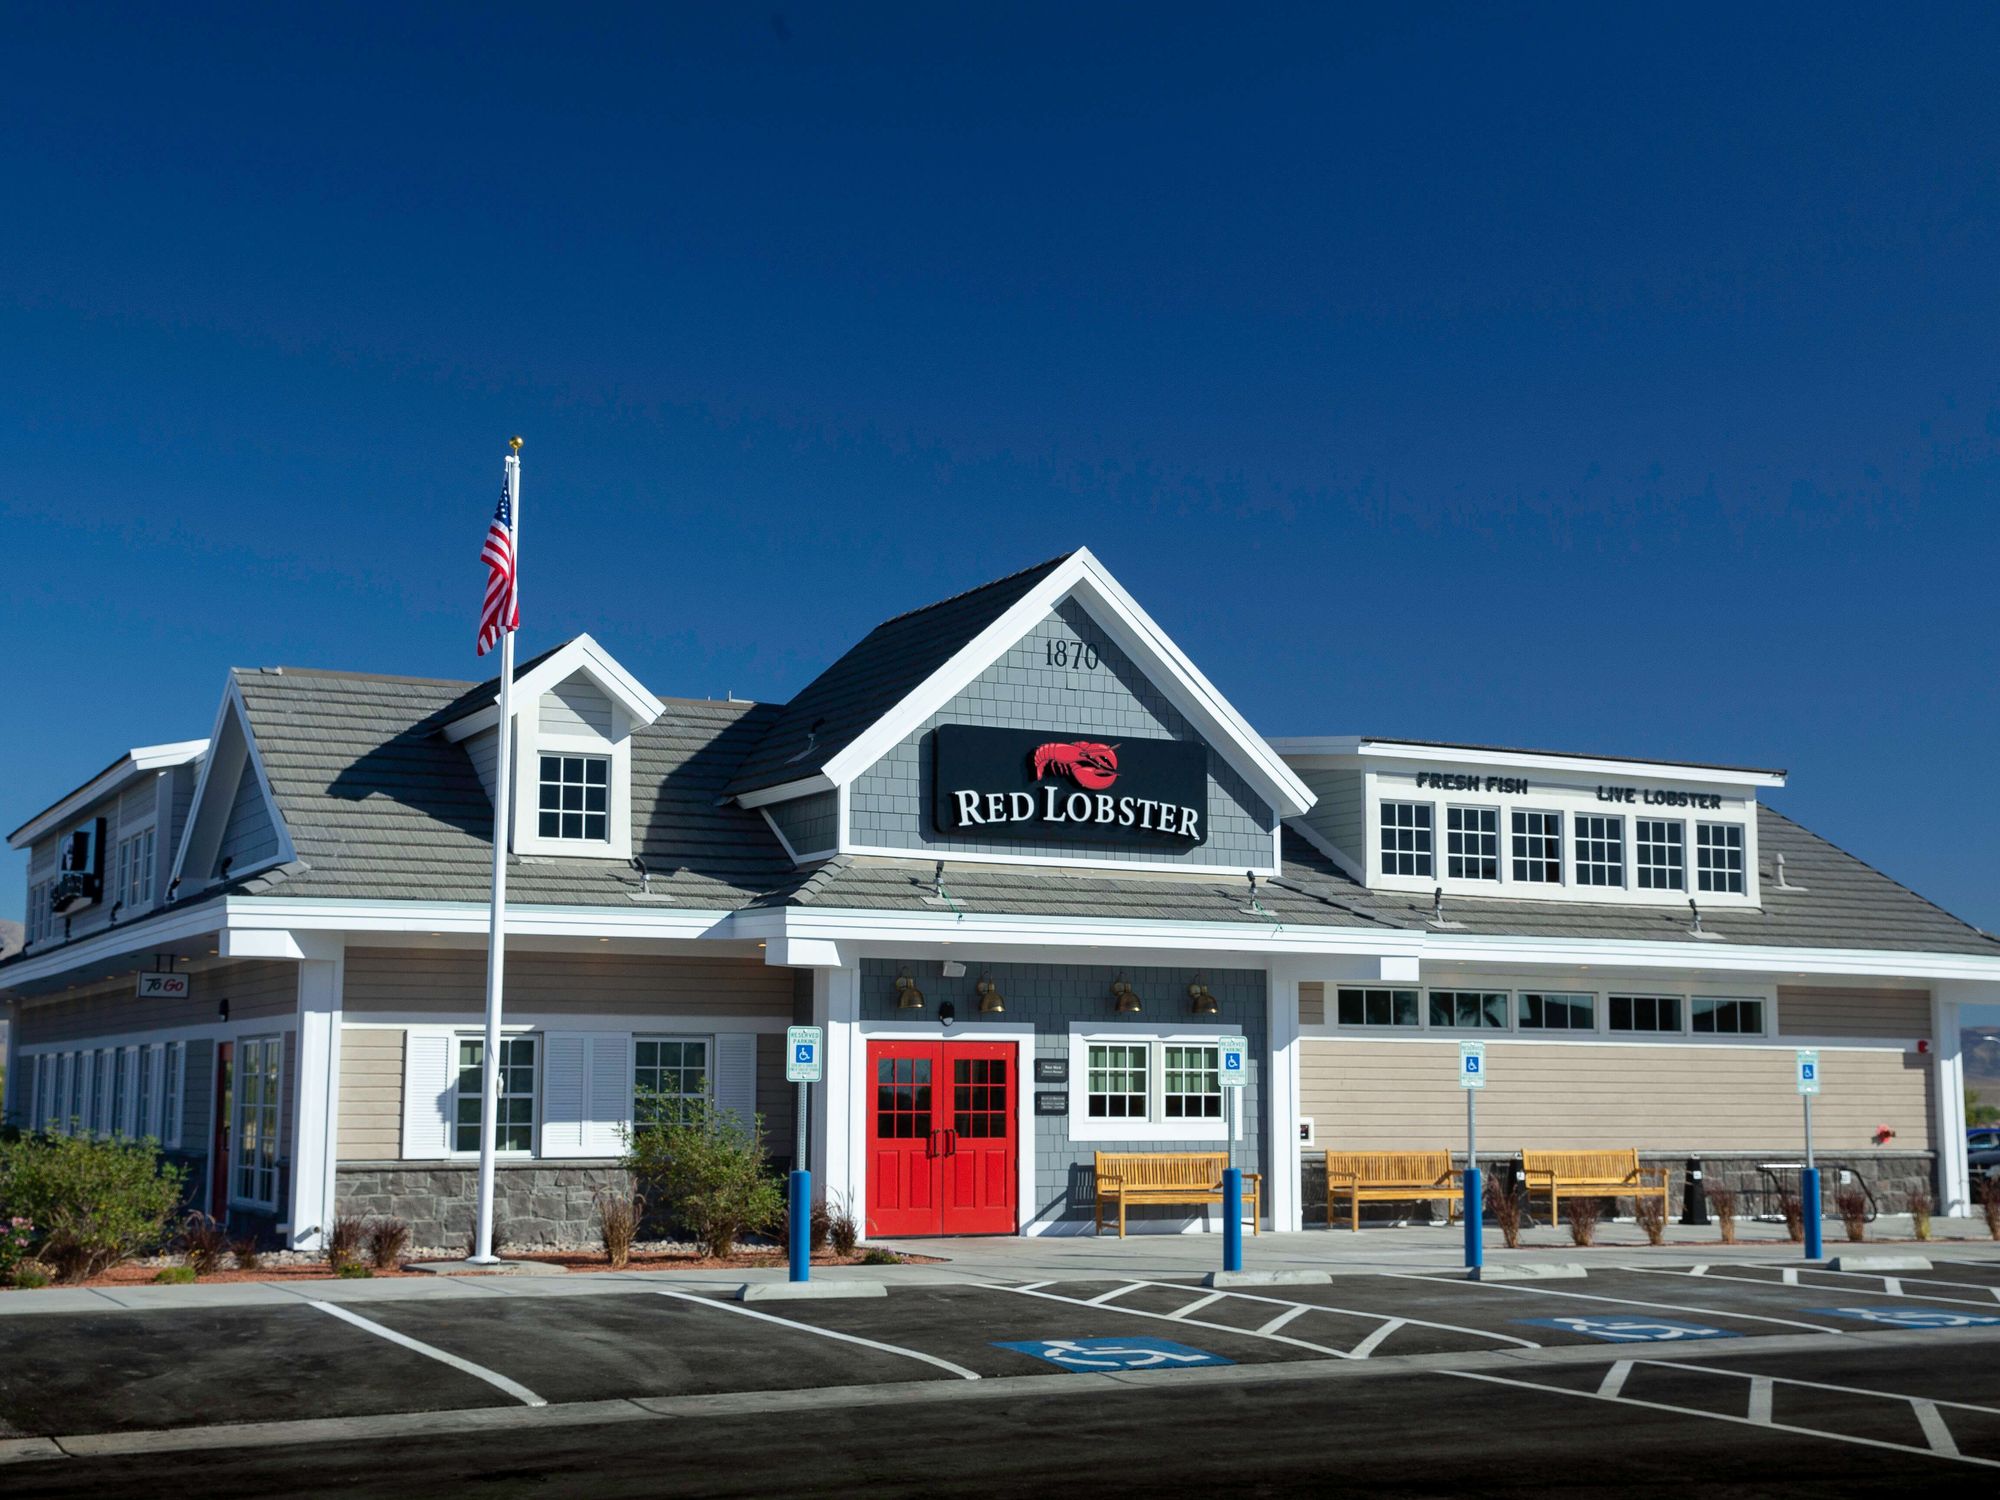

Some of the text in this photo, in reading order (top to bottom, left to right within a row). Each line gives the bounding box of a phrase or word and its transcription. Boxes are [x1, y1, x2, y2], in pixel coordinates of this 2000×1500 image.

[1046, 639, 1099, 670] 1870
[1416, 772, 1528, 795] FRESH FISH
[1596, 785, 1722, 810] LIVE LOBSTER
[954, 785, 1200, 841] RED LOBSTER
